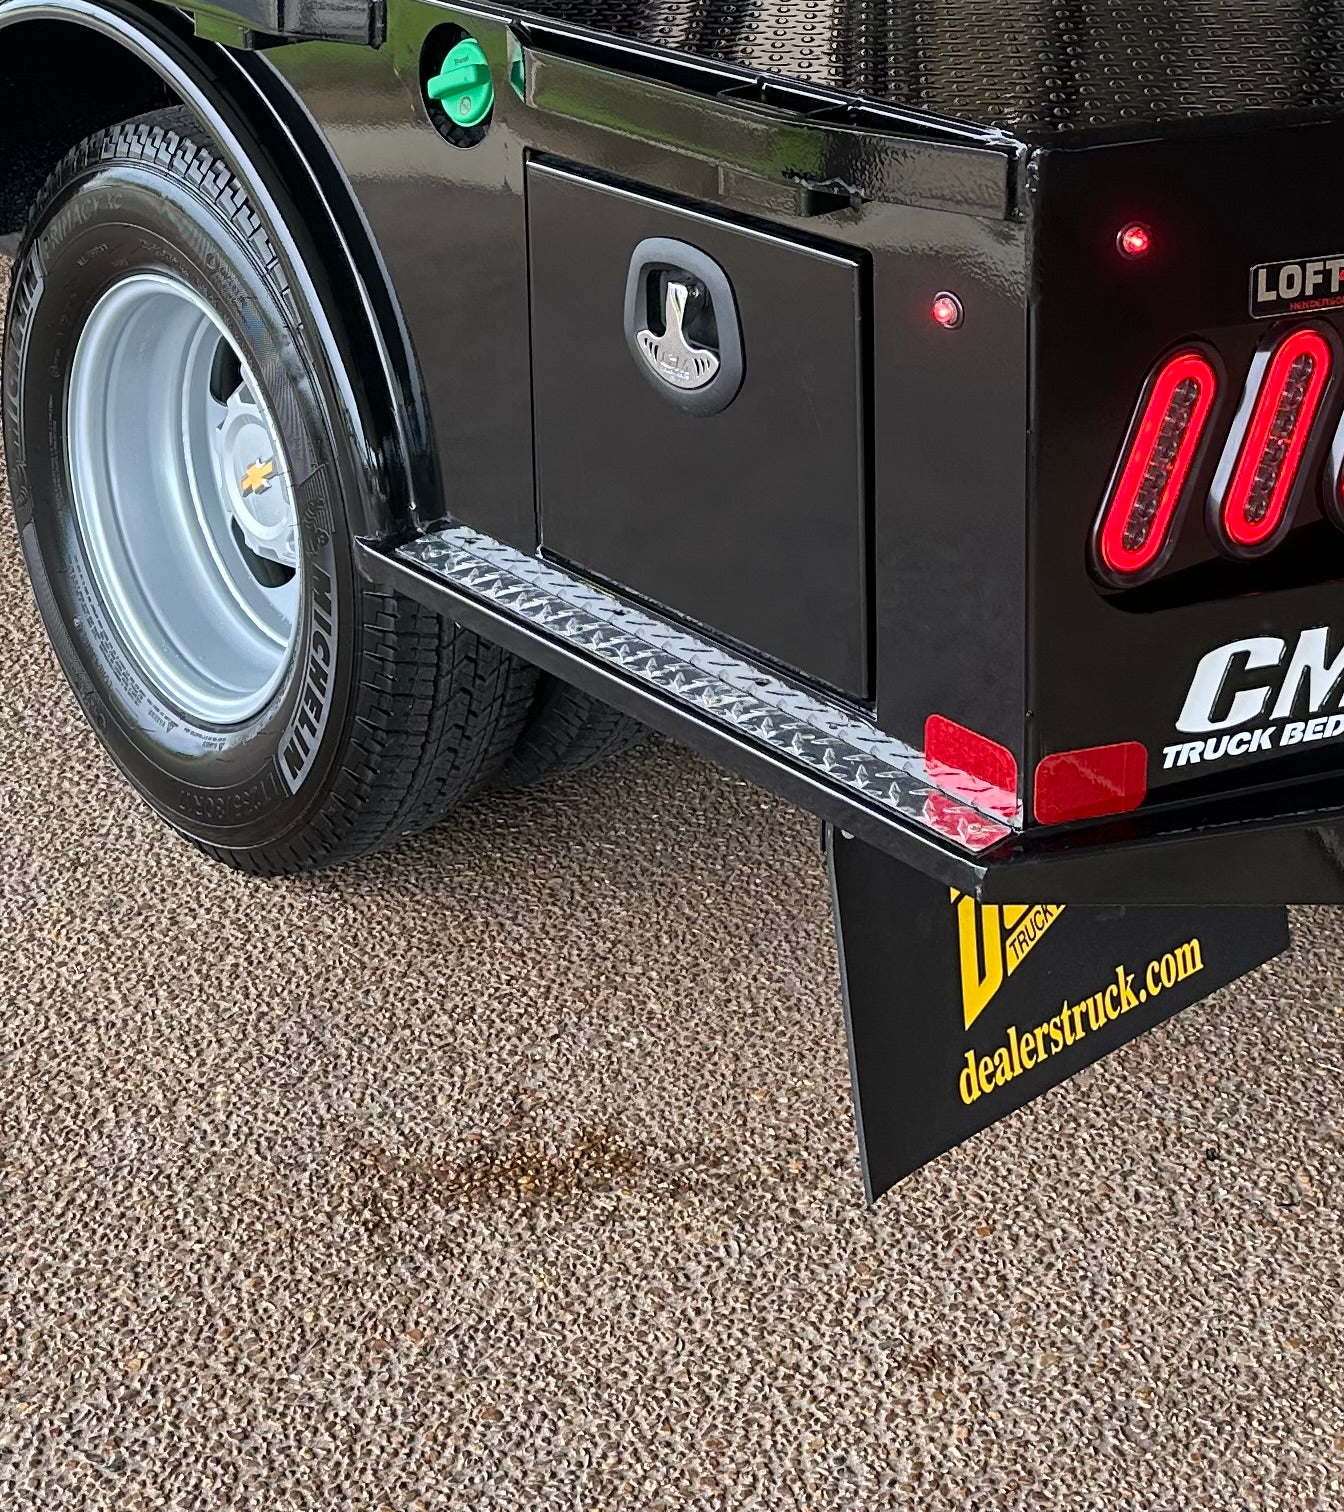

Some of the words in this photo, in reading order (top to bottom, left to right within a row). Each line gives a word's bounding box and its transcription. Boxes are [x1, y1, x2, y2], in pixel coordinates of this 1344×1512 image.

[282, 562, 333, 781] MICHELIN
[1162, 726, 1277, 770] TRUCK
[959, 938, 1205, 1105] dealerstruck.com
